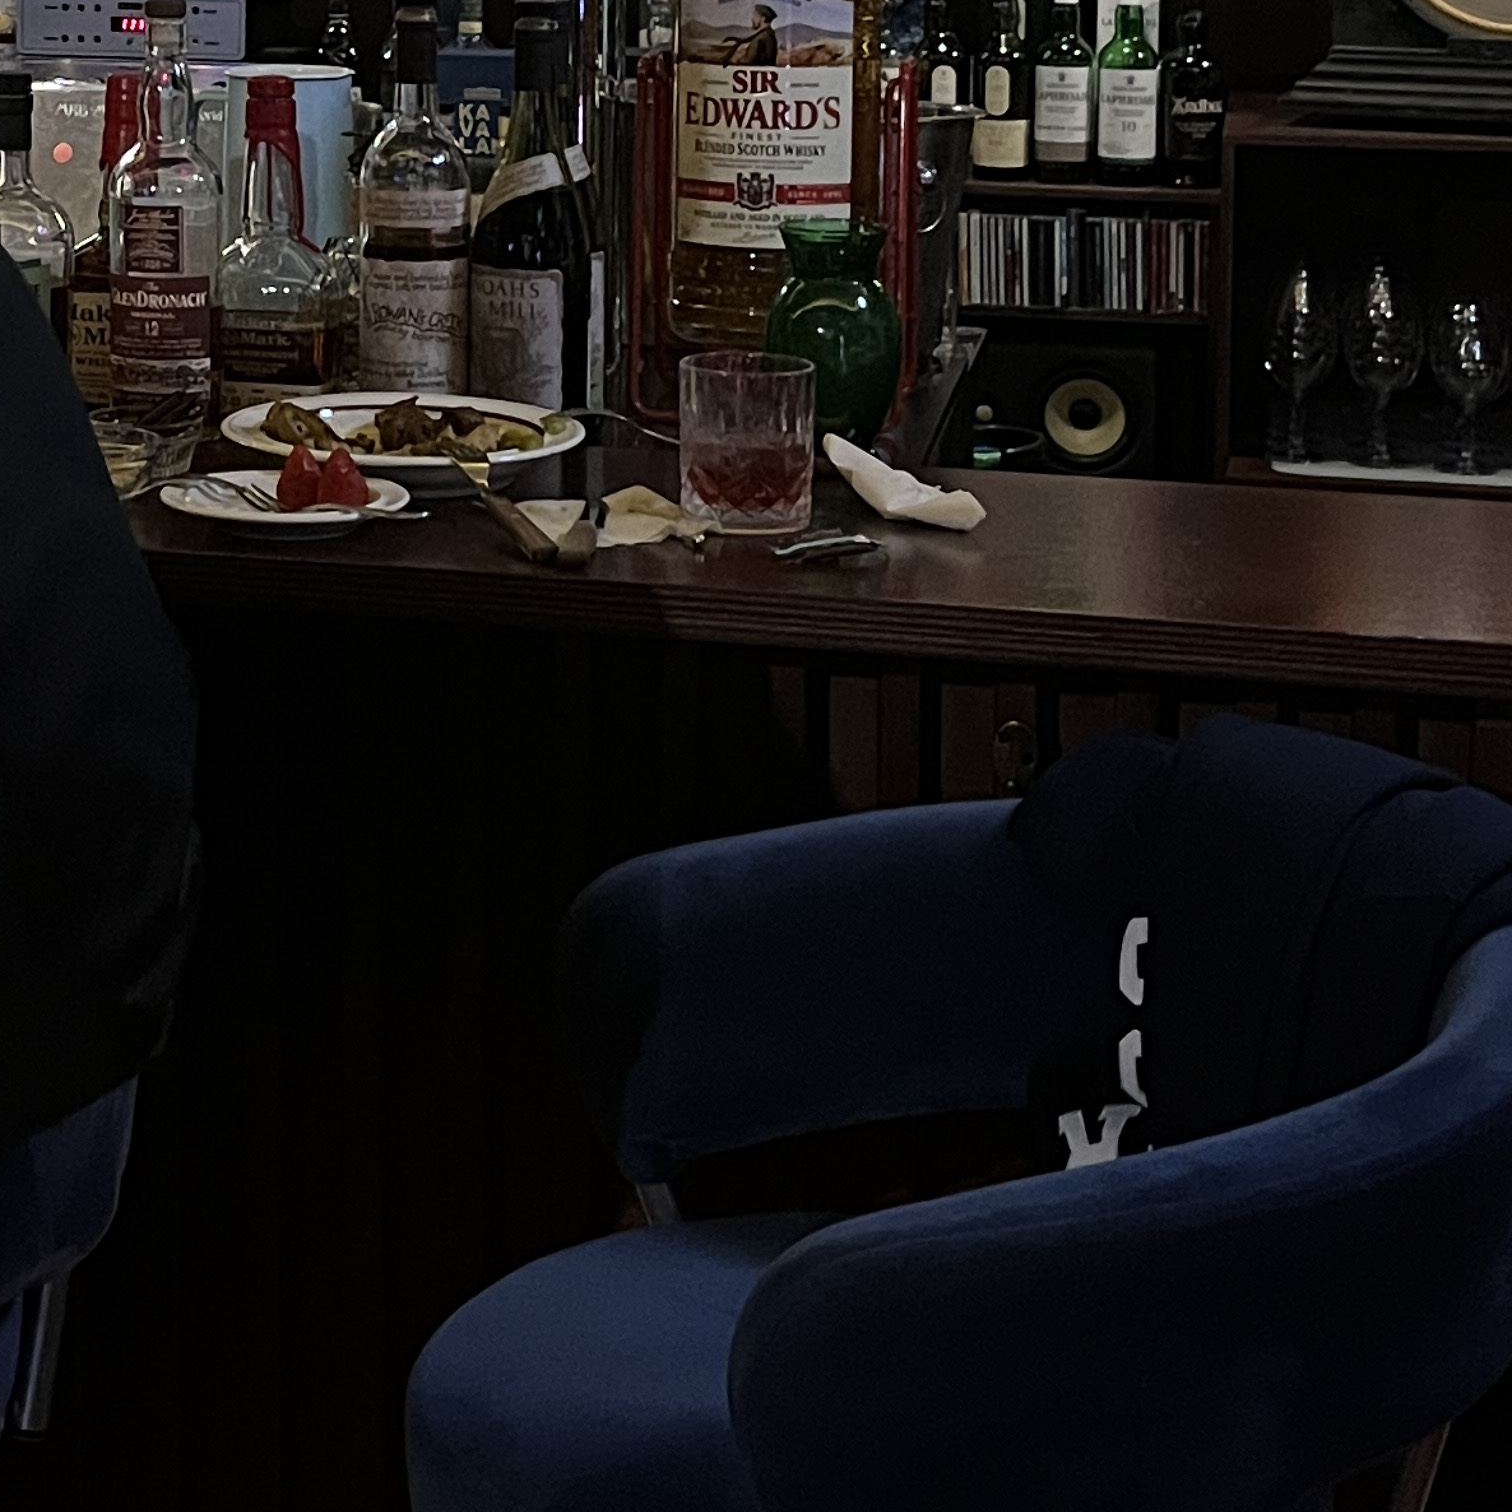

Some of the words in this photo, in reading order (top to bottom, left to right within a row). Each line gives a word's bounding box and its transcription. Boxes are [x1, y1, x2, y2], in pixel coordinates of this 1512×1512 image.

[732, 70, 782, 94] SIR
[685, 92, 841, 130] EDWARD'S
[1121, 120, 1137, 133] 10
[738, 142, 781, 157] SCOTCH
[783, 143, 826, 158] WHISKY
[144, 320, 160, 337] 12
